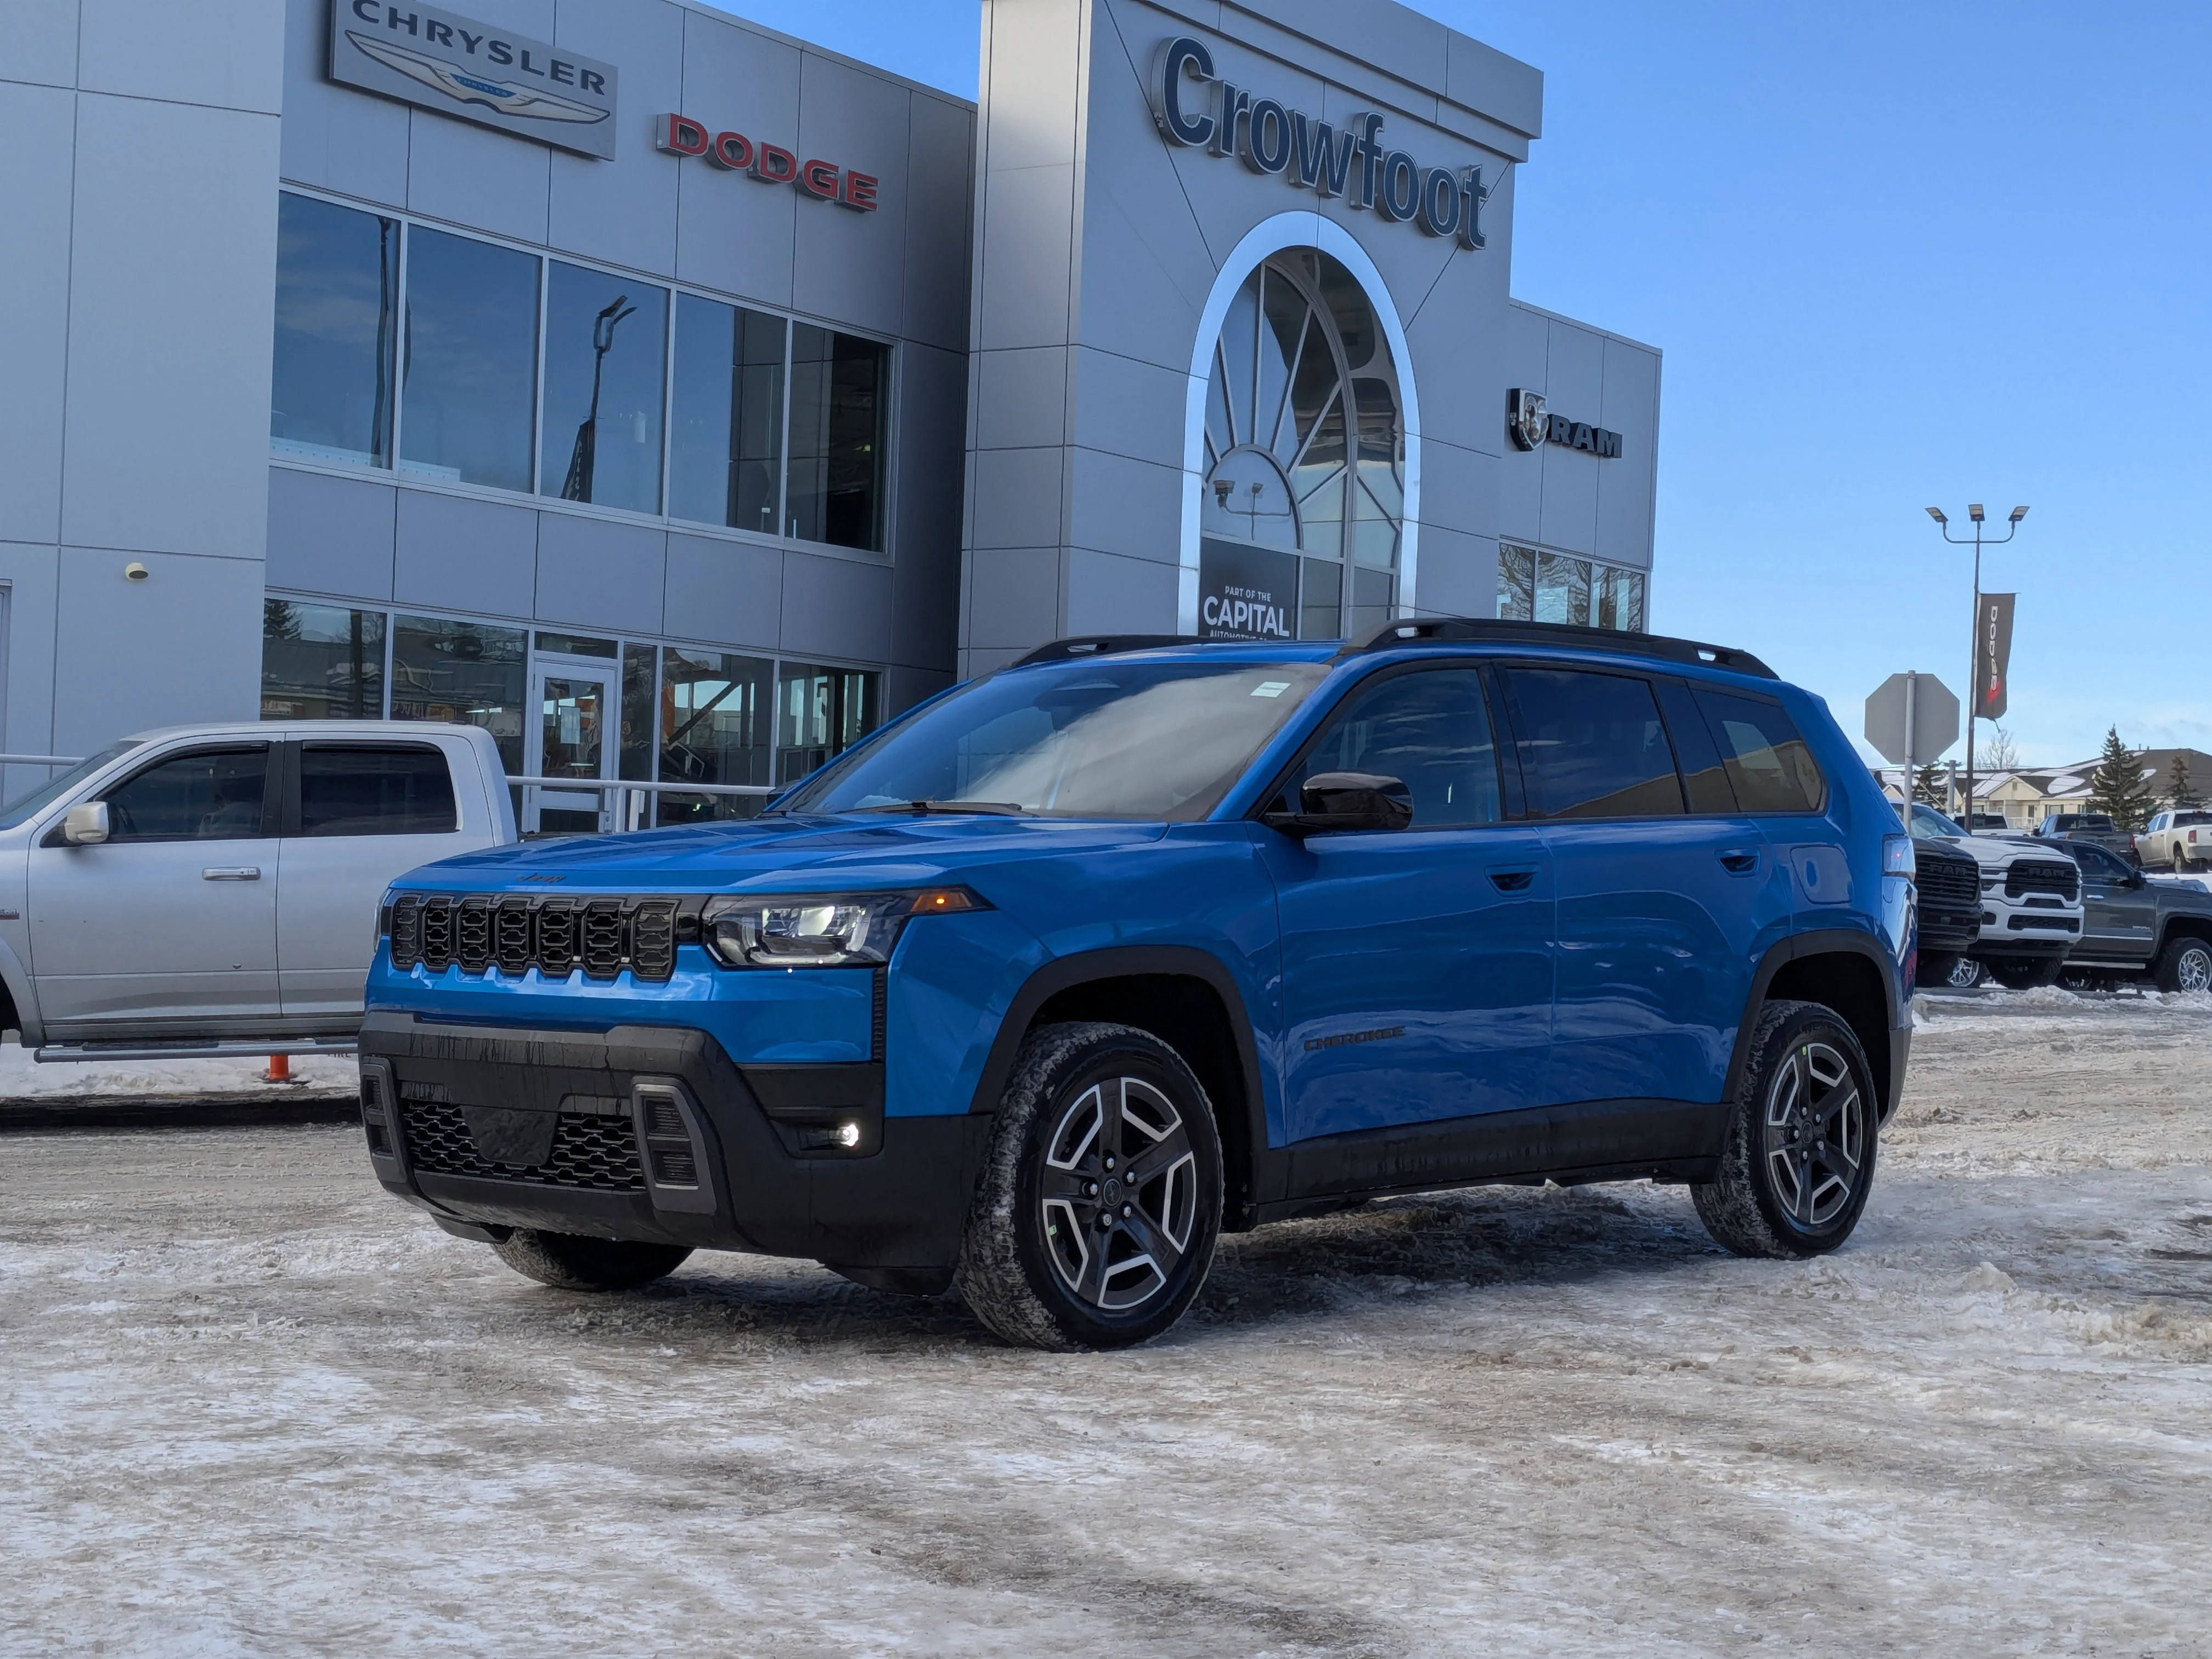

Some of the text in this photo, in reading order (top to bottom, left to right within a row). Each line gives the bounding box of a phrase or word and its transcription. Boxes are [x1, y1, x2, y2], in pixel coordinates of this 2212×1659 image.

[352, 0, 606, 95] CHRYSLER
[657, 112, 878, 213] DODGE
[1151, 35, 1488, 251] Crowfoot
[1548, 414, 1623, 459] RAM
[1224, 585, 1272, 602] PART OF THE
[1203, 596, 1290, 637] CAPITAL
[1304, 1025, 1406, 1052] CHEROKEE
